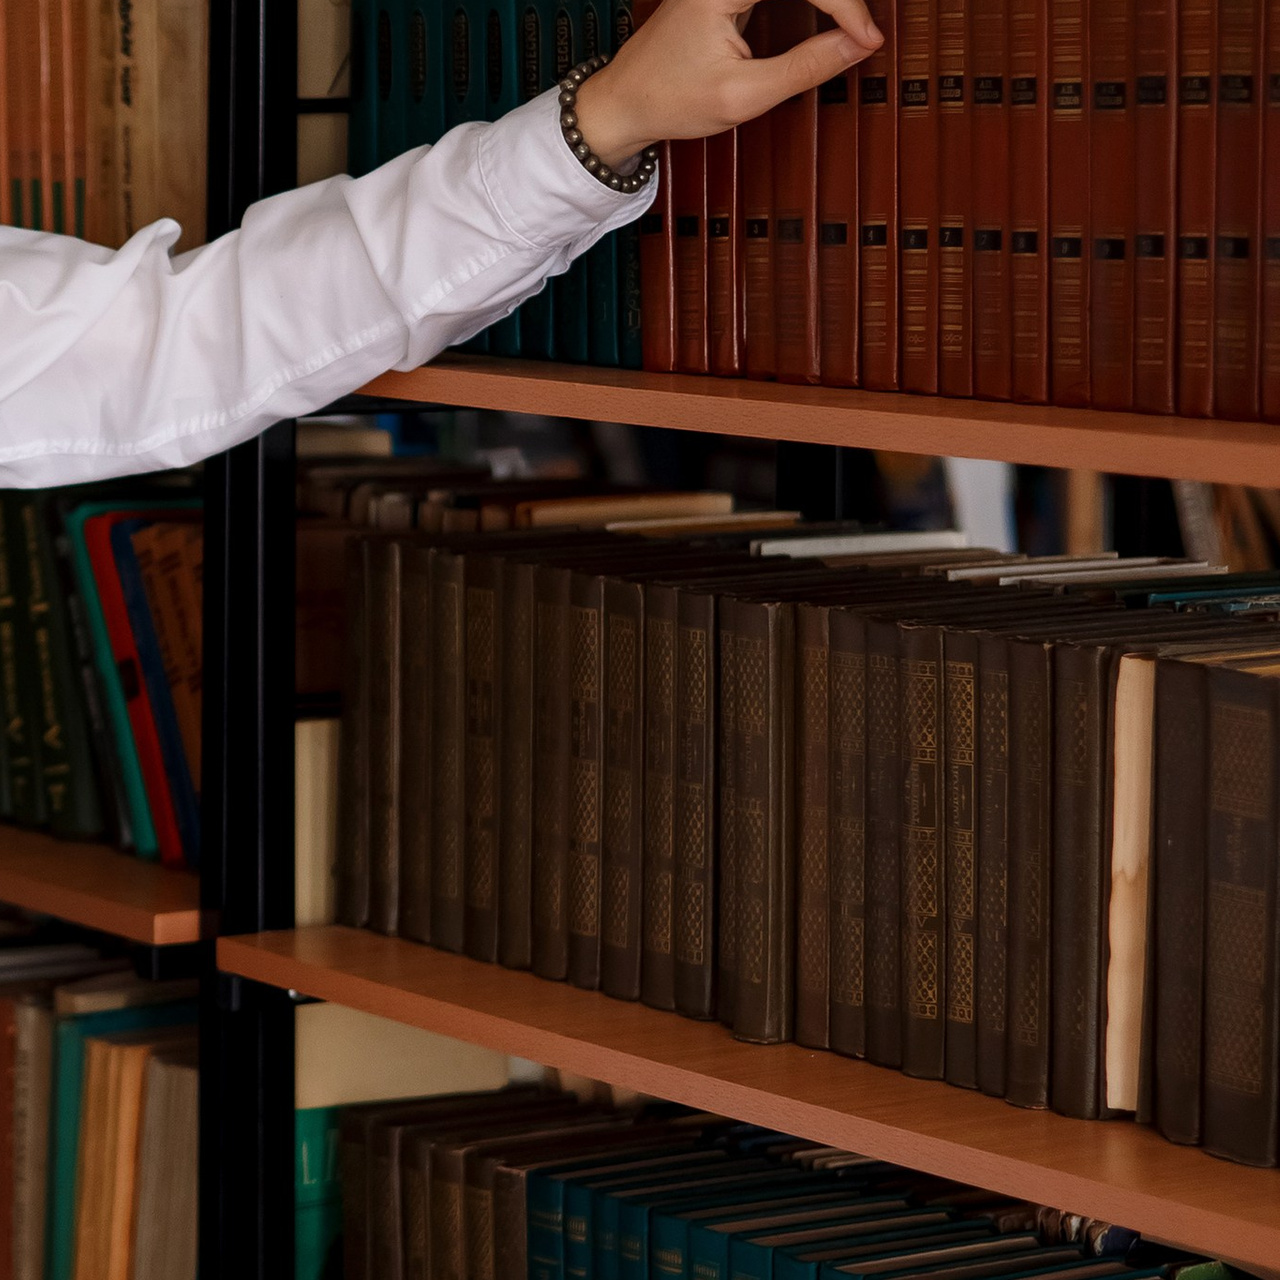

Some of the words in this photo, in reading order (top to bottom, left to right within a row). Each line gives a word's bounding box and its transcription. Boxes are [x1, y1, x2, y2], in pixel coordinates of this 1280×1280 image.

[583, 10, 595, 58] ЕСКОВ
[753, 223, 759, 235] 3
[944, 232, 950, 242] 7
